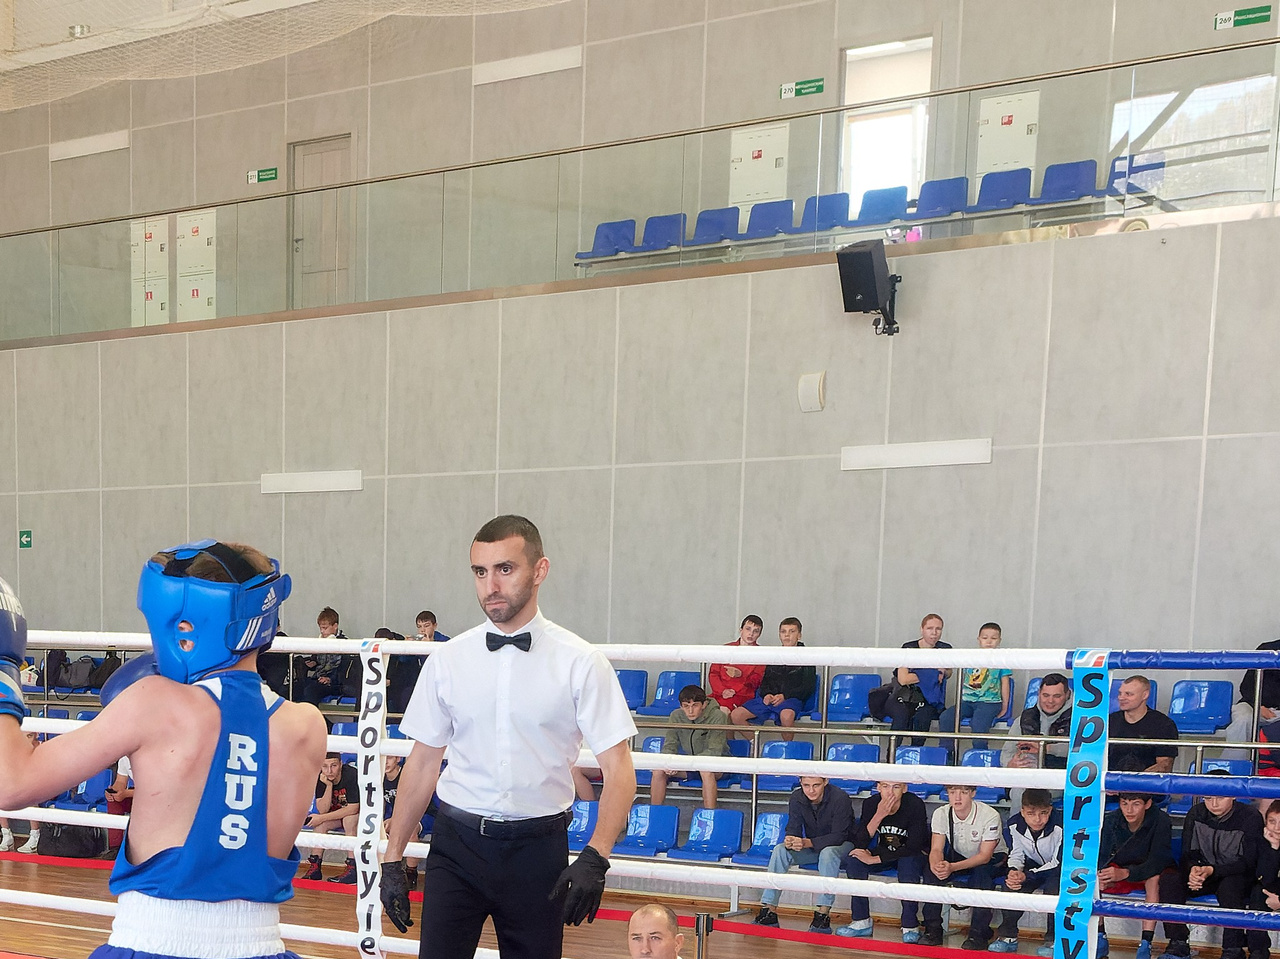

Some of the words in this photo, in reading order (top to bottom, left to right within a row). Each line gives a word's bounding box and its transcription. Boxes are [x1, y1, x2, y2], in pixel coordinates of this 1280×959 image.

[1219, 16, 1232, 24] 269
[219, 732, 258, 850] RUS
[360, 656, 382, 956] Sportstyle
